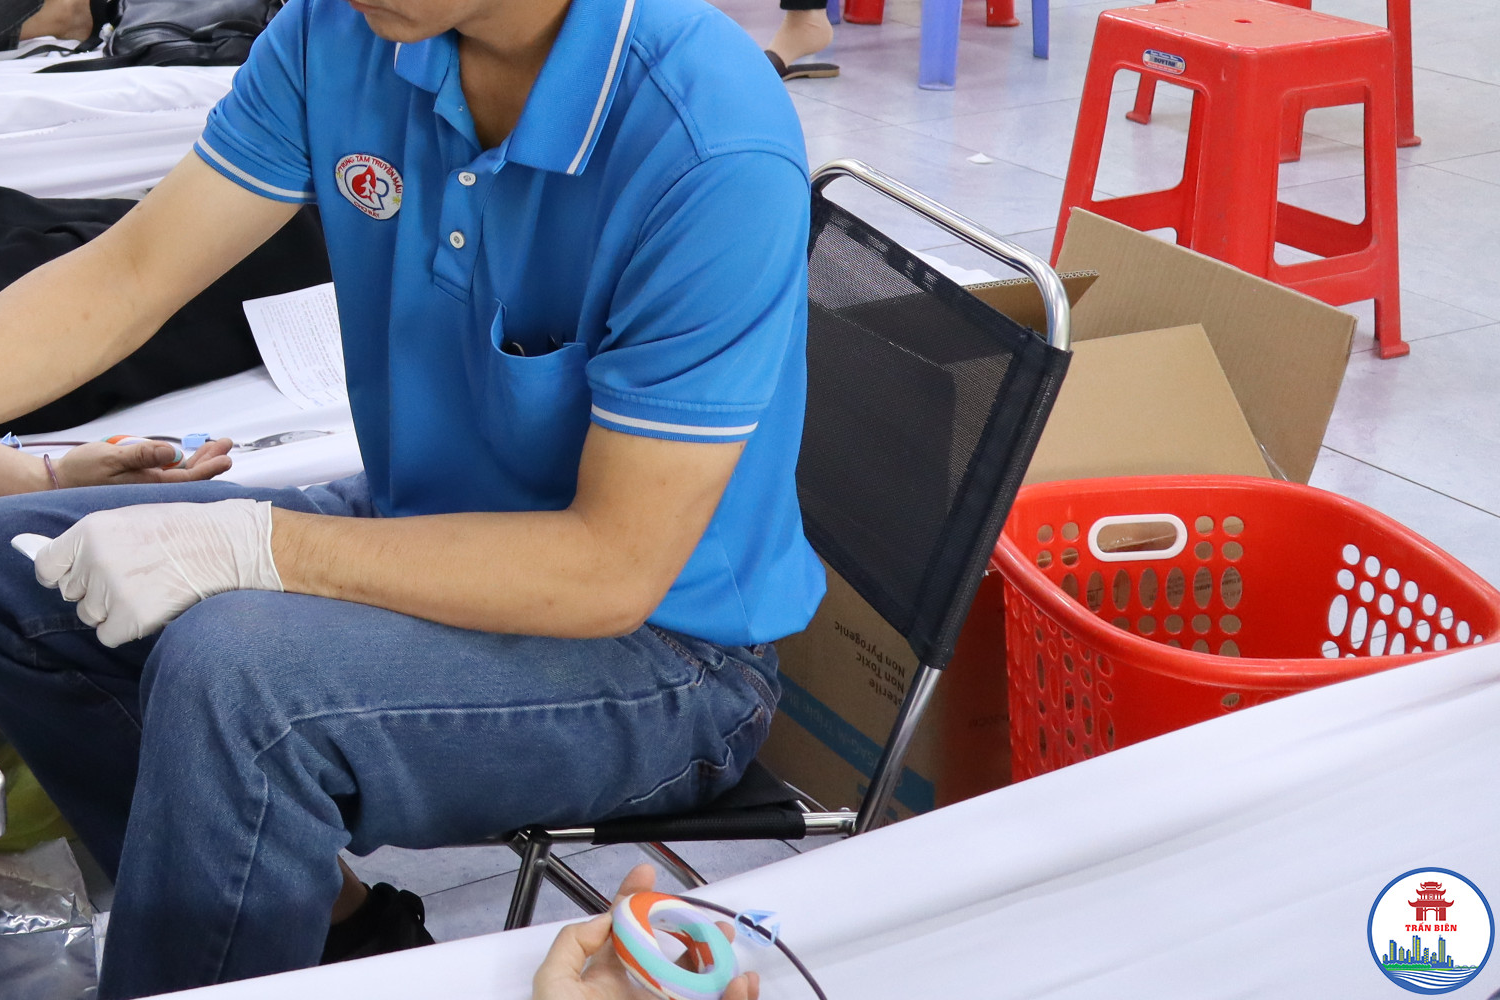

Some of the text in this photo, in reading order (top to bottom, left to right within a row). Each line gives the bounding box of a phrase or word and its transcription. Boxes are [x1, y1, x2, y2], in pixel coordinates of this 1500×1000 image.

[355, 153, 370, 163] TÂM
[833, 620, 906, 678] Non Pyrogenic
[855, 651, 906, 694] Non Toxic
